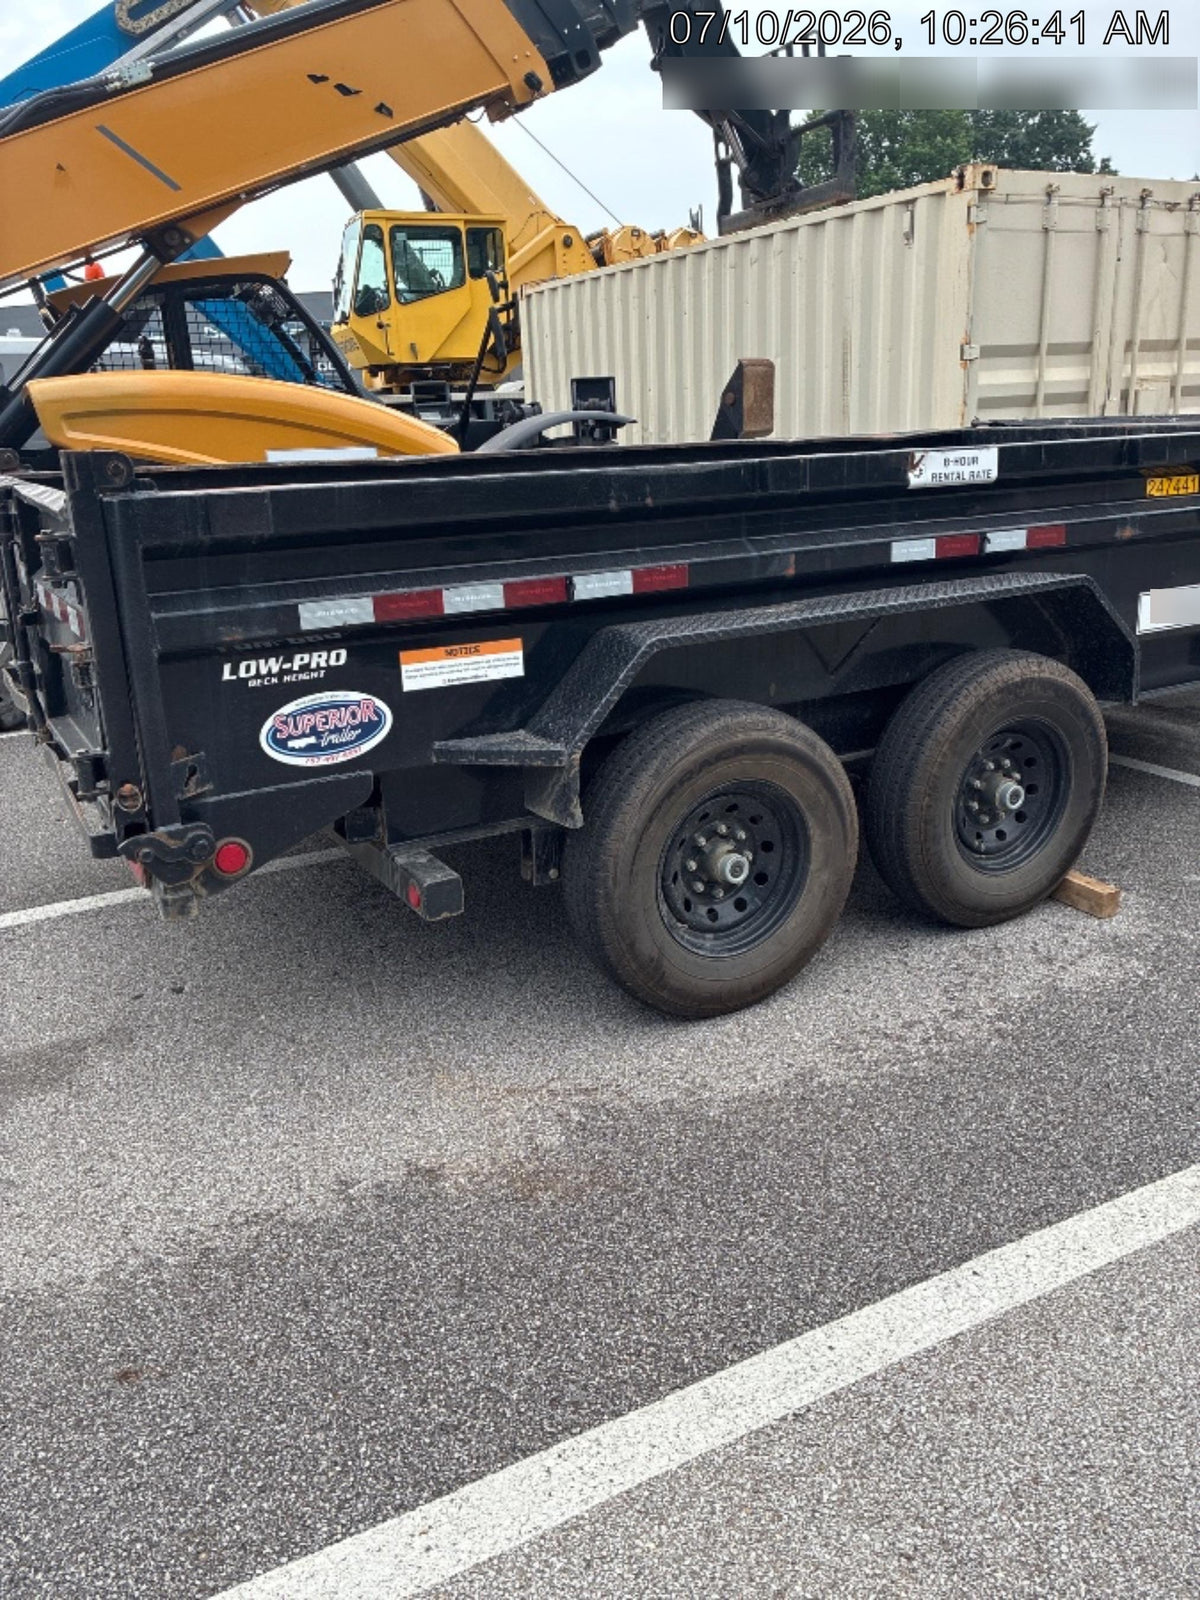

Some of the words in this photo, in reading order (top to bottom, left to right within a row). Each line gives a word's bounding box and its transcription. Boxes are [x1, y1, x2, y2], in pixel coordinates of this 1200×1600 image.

[931, 470, 967, 483] RENTAL
[968, 468, 993, 481] RATE
[444, 645, 481, 657] NOTICE
[221, 648, 348, 682] LOW-PRO
[247, 676, 279, 688] DECK
[283, 669, 327, 683] HEIGHT
[273, 698, 379, 739] SUPERIOR
